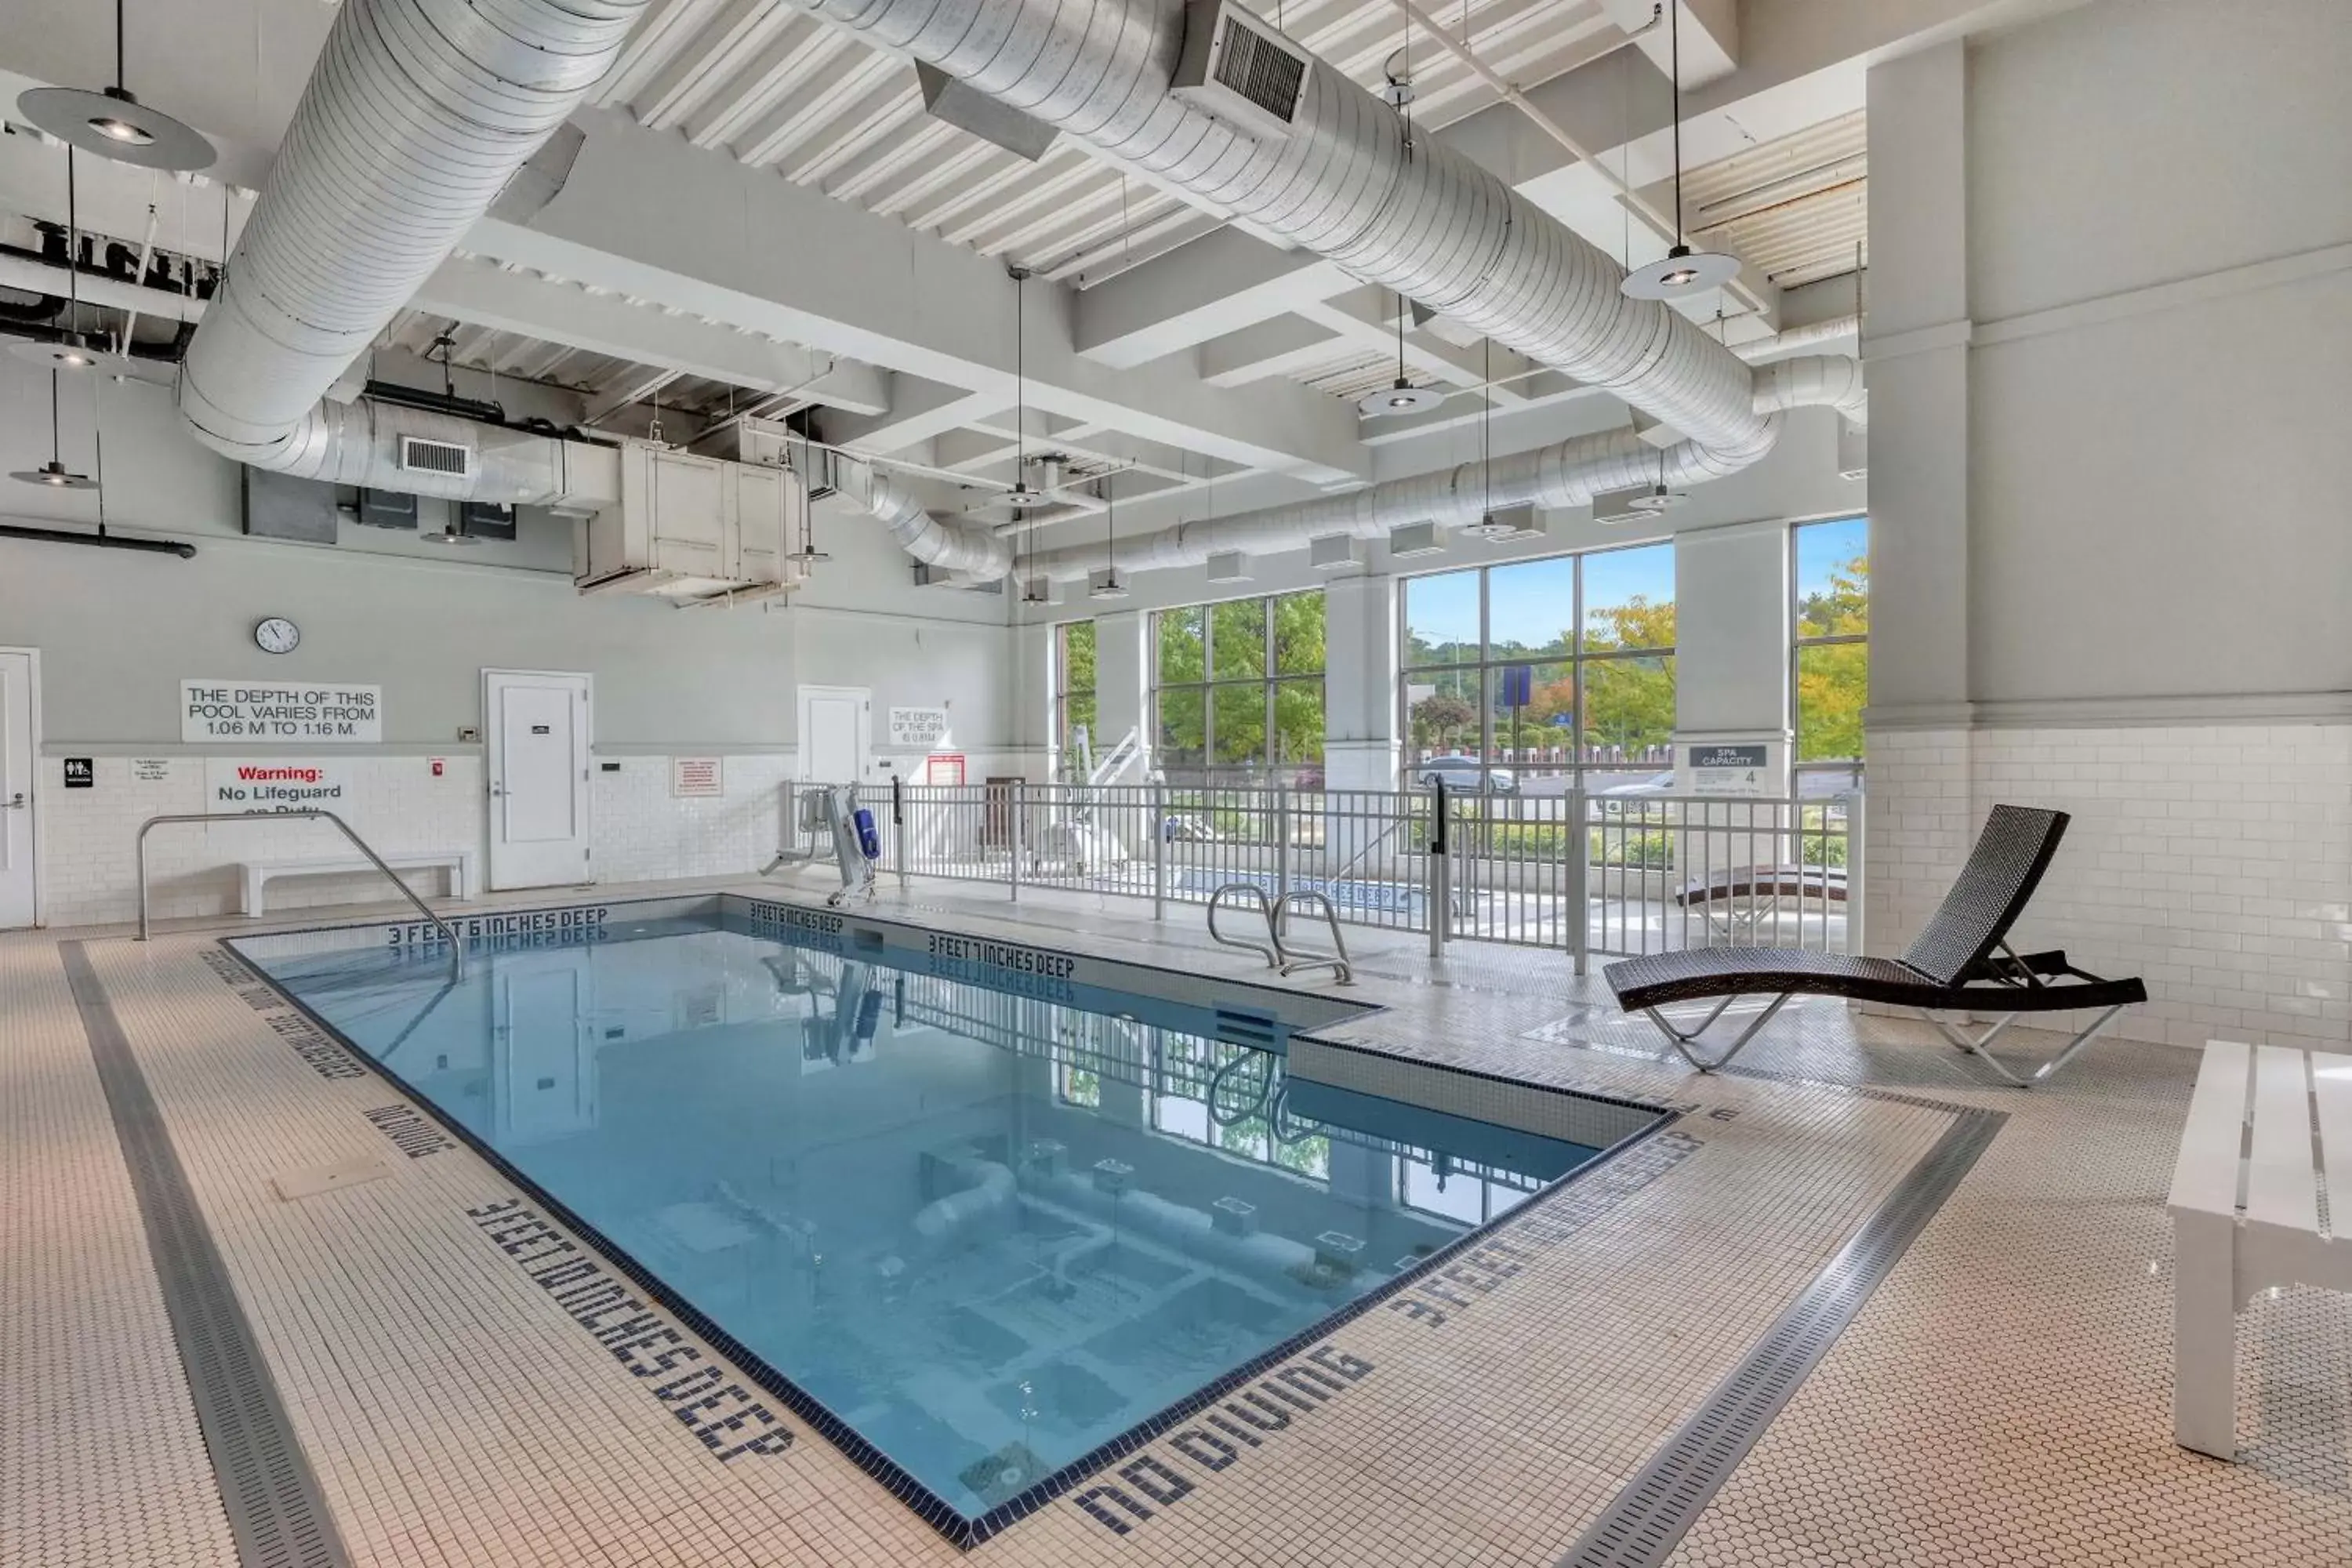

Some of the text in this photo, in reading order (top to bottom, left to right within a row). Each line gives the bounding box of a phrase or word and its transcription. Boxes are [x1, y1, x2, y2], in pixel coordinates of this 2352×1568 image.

[187, 688, 374, 706] THE DEPTH OF THIS
[189, 704, 375, 720] POOL VARIES FROM
[893, 710, 943, 722] THE DEPTH
[206, 721, 357, 735] 1.06 M TO 1.16 M.
[892, 722, 906, 732] OF
[909, 722, 926, 731] THE
[1702, 756, 1753, 766] CAPACITY
[238, 767, 324, 782] Warning:
[1745, 770, 1757, 785] 4
[218, 785, 341, 801] No Lifeguard
[388, 909, 608, 944] 3 FEET 6 INCHES DEEP
[757, 903, 777, 921] FEET
[819, 915, 843, 934] DEEP
[928, 935, 1075, 978] 3 FEET 7 INCHES DEEP
[466, 1198, 520, 1218] 3
[478, 1210, 577, 1264] FEET
[554, 1277, 702, 1378] INCHES
[652, 1366, 796, 1463] DEEP
[1073, 1345, 1376, 1535] NO DIVING
